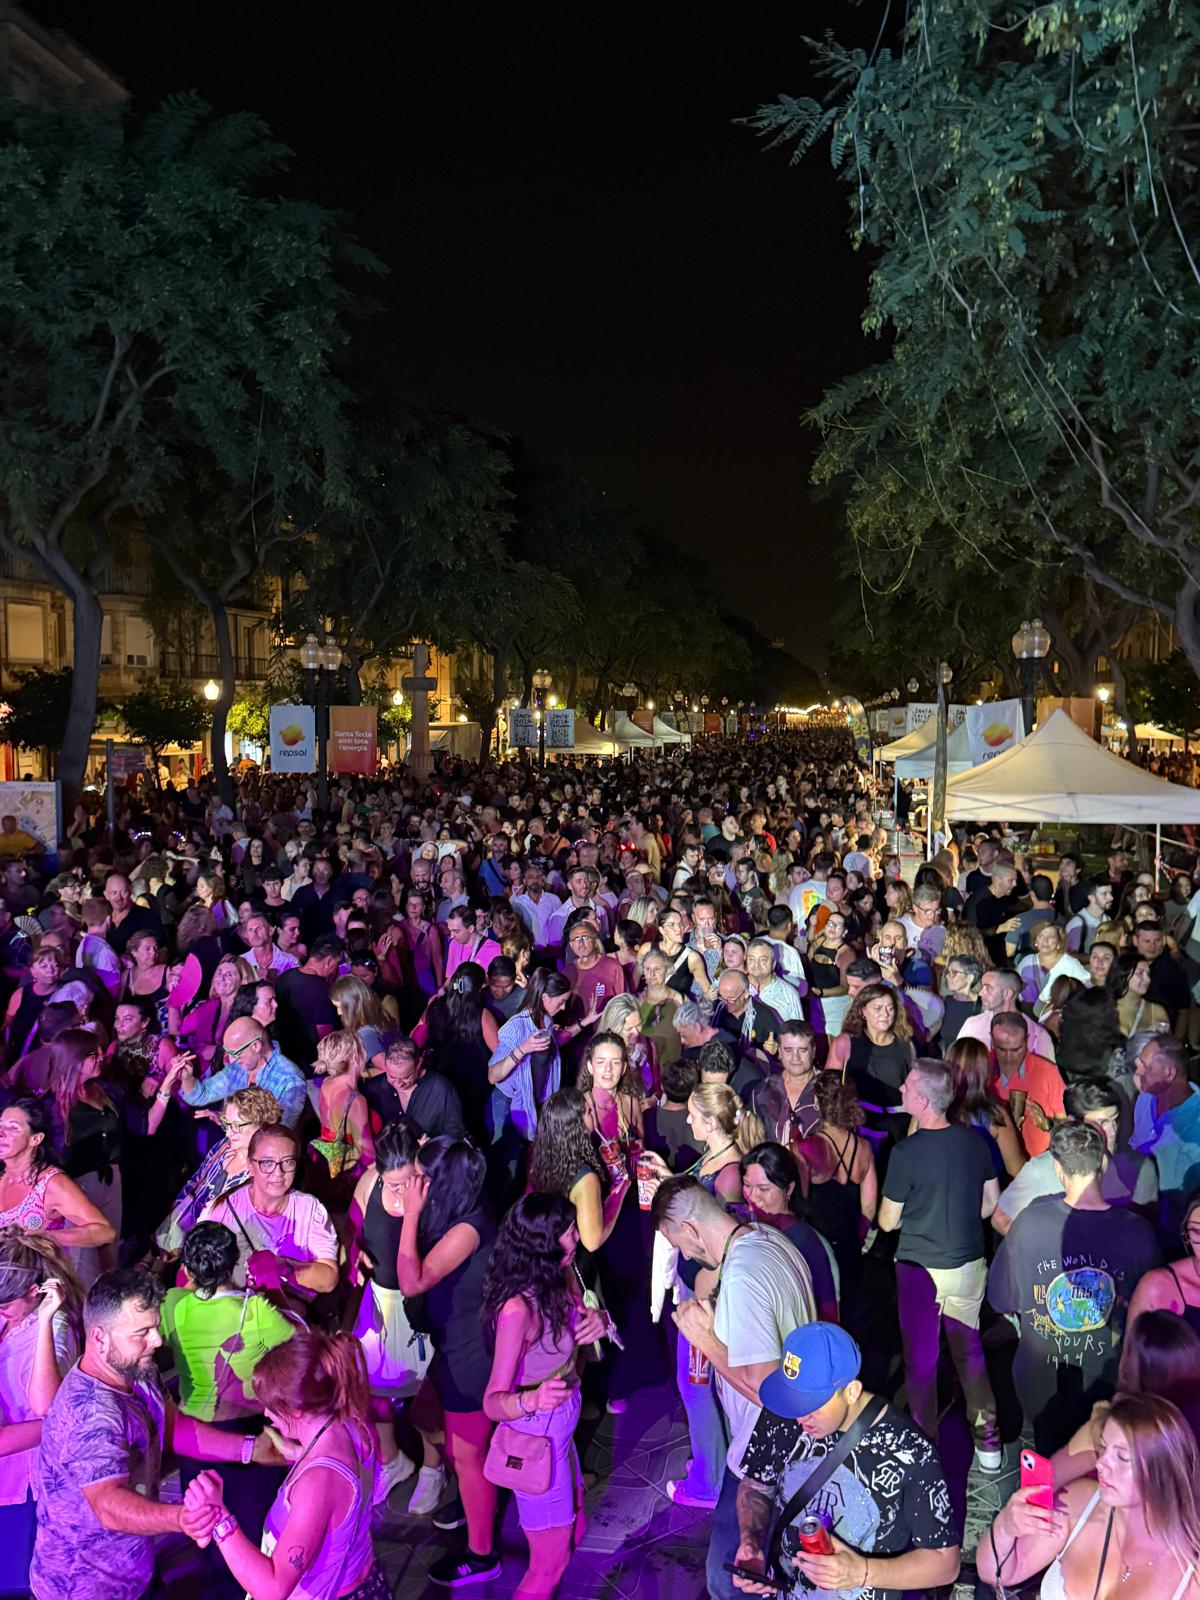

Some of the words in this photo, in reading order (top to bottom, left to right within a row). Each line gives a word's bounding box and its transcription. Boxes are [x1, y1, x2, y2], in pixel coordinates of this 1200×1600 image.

[280, 747, 308, 757] repsol
[1037, 1260, 1057, 1275] THE
[1063, 1253, 1108, 1269] WORLD
[1055, 1334, 1106, 1356] YOURS
[1046, 1352, 1084, 1370] 1994
